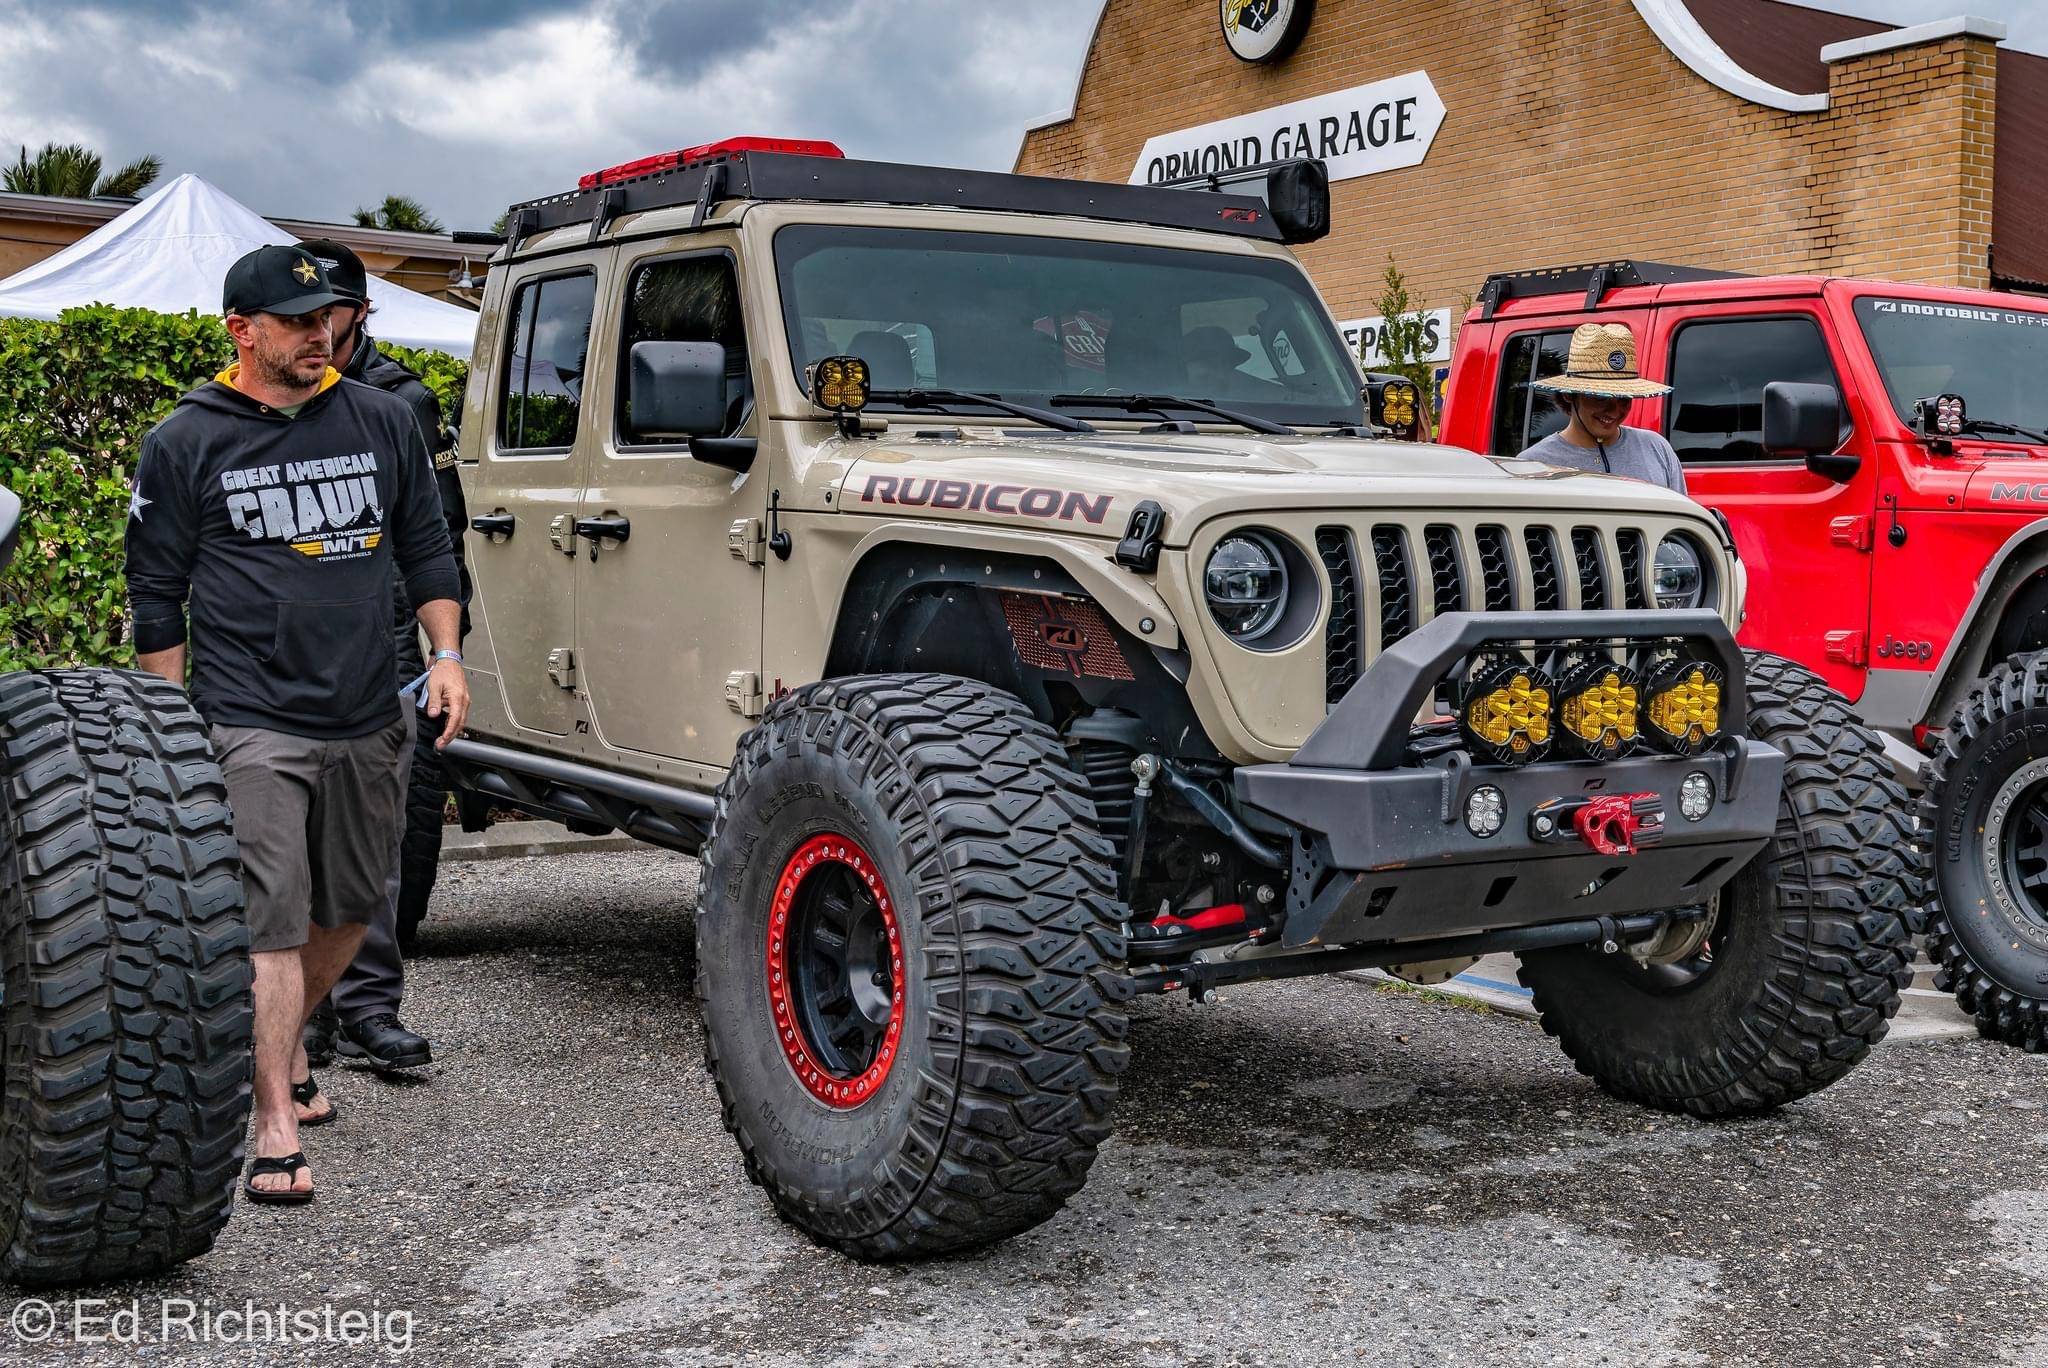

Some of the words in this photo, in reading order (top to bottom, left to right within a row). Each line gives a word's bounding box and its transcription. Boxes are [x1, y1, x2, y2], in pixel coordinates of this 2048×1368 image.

[1147, 136, 1261, 184] ORMOND
[1271, 97, 1417, 160] GARAGE
[1901, 303, 2000, 322] MOTOBILT
[221, 465, 280, 491] GREAT
[285, 452, 378, 483] AMERICAN
[226, 476, 382, 542] CRAWL
[861, 475, 1114, 524] RUBICON
[292, 532, 333, 543] MICKEY
[323, 535, 369, 554] M/T
[1877, 634, 1933, 664] Jeep
